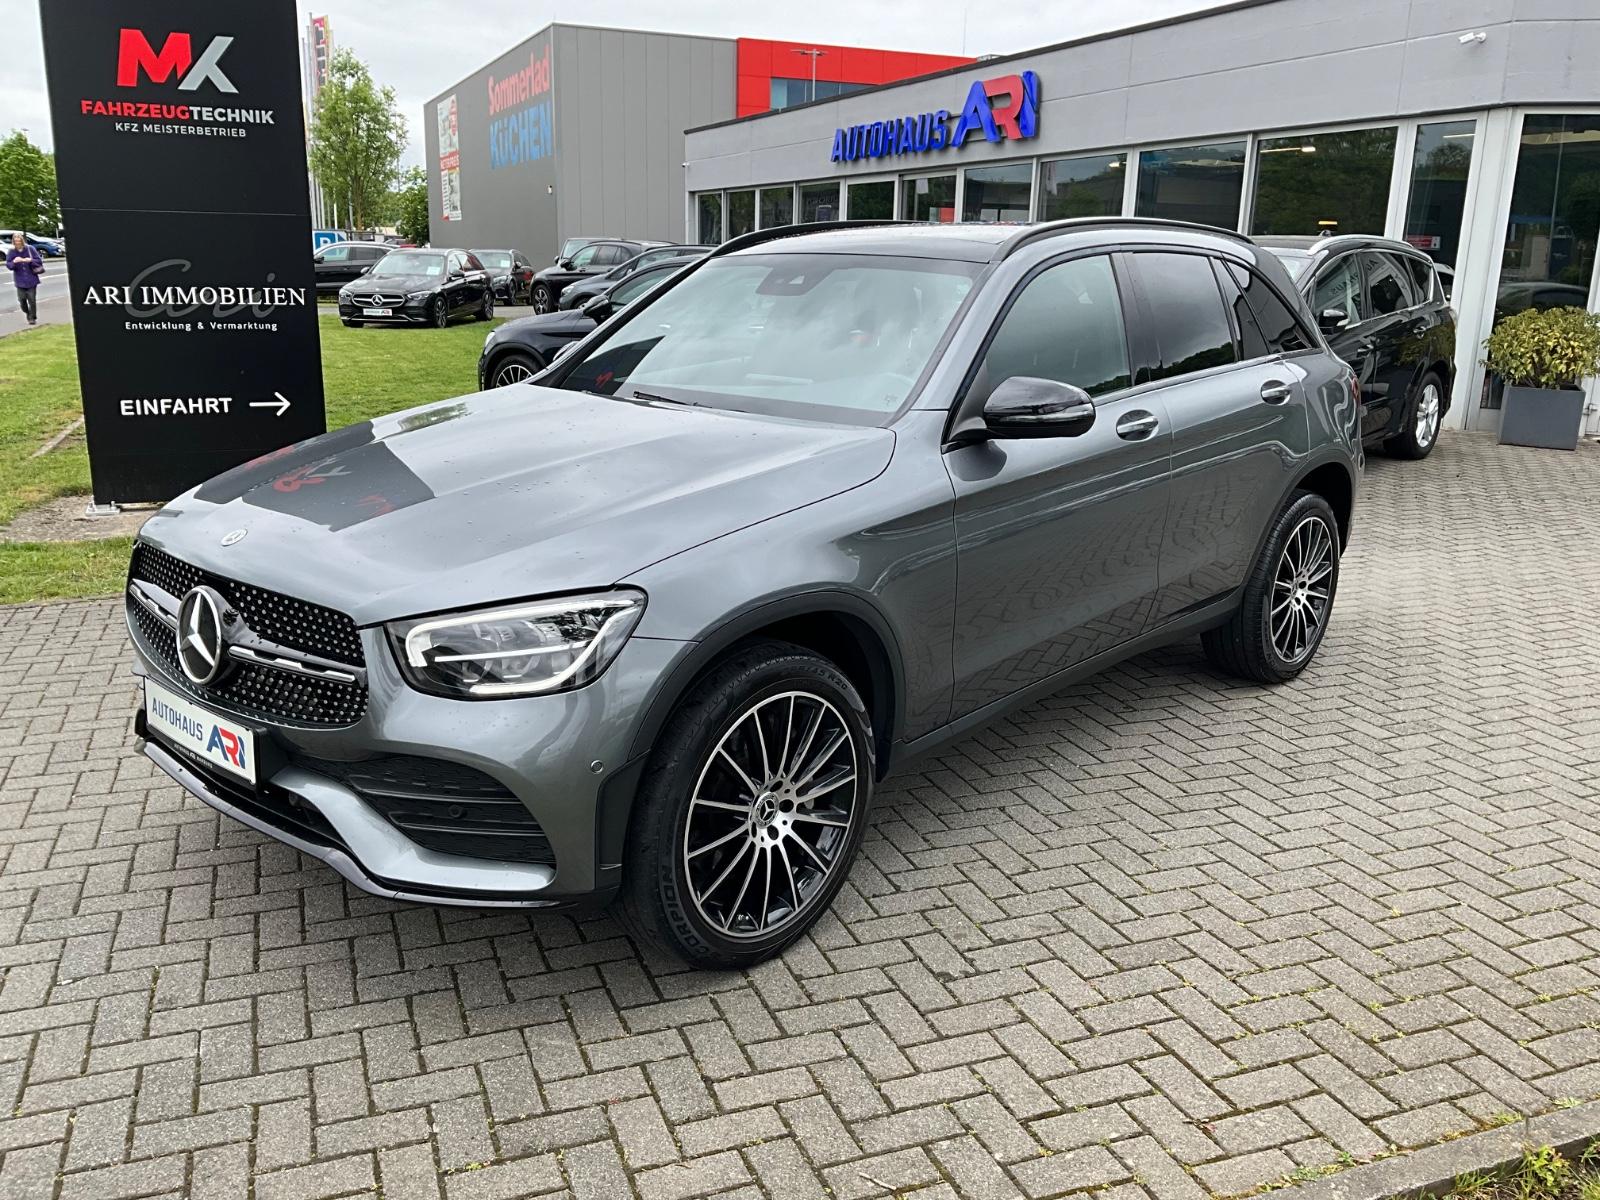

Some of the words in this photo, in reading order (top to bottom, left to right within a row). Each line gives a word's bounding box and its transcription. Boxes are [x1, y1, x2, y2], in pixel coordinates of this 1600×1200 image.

[117, 28, 239, 93] MK
[488, 44, 550, 116] Sommerlad
[80, 100, 275, 124] FAHRZEUGTECHNIK
[115, 122, 139, 132] KFZ
[143, 124, 247, 137] MEISTERBETRIEB
[490, 102, 552, 170] KÜCHEN
[831, 110, 950, 162] AUTOHAUS
[83, 286, 132, 305] ARI
[140, 286, 306, 306] IMMOBILIEN
[125, 321, 192, 332] Entwicklung
[197, 322, 204, 330] &
[210, 321, 278, 332] Vermarktung
[120, 397, 233, 416] EINFAHRT
[152, 697, 203, 741] AUTOHAUS
